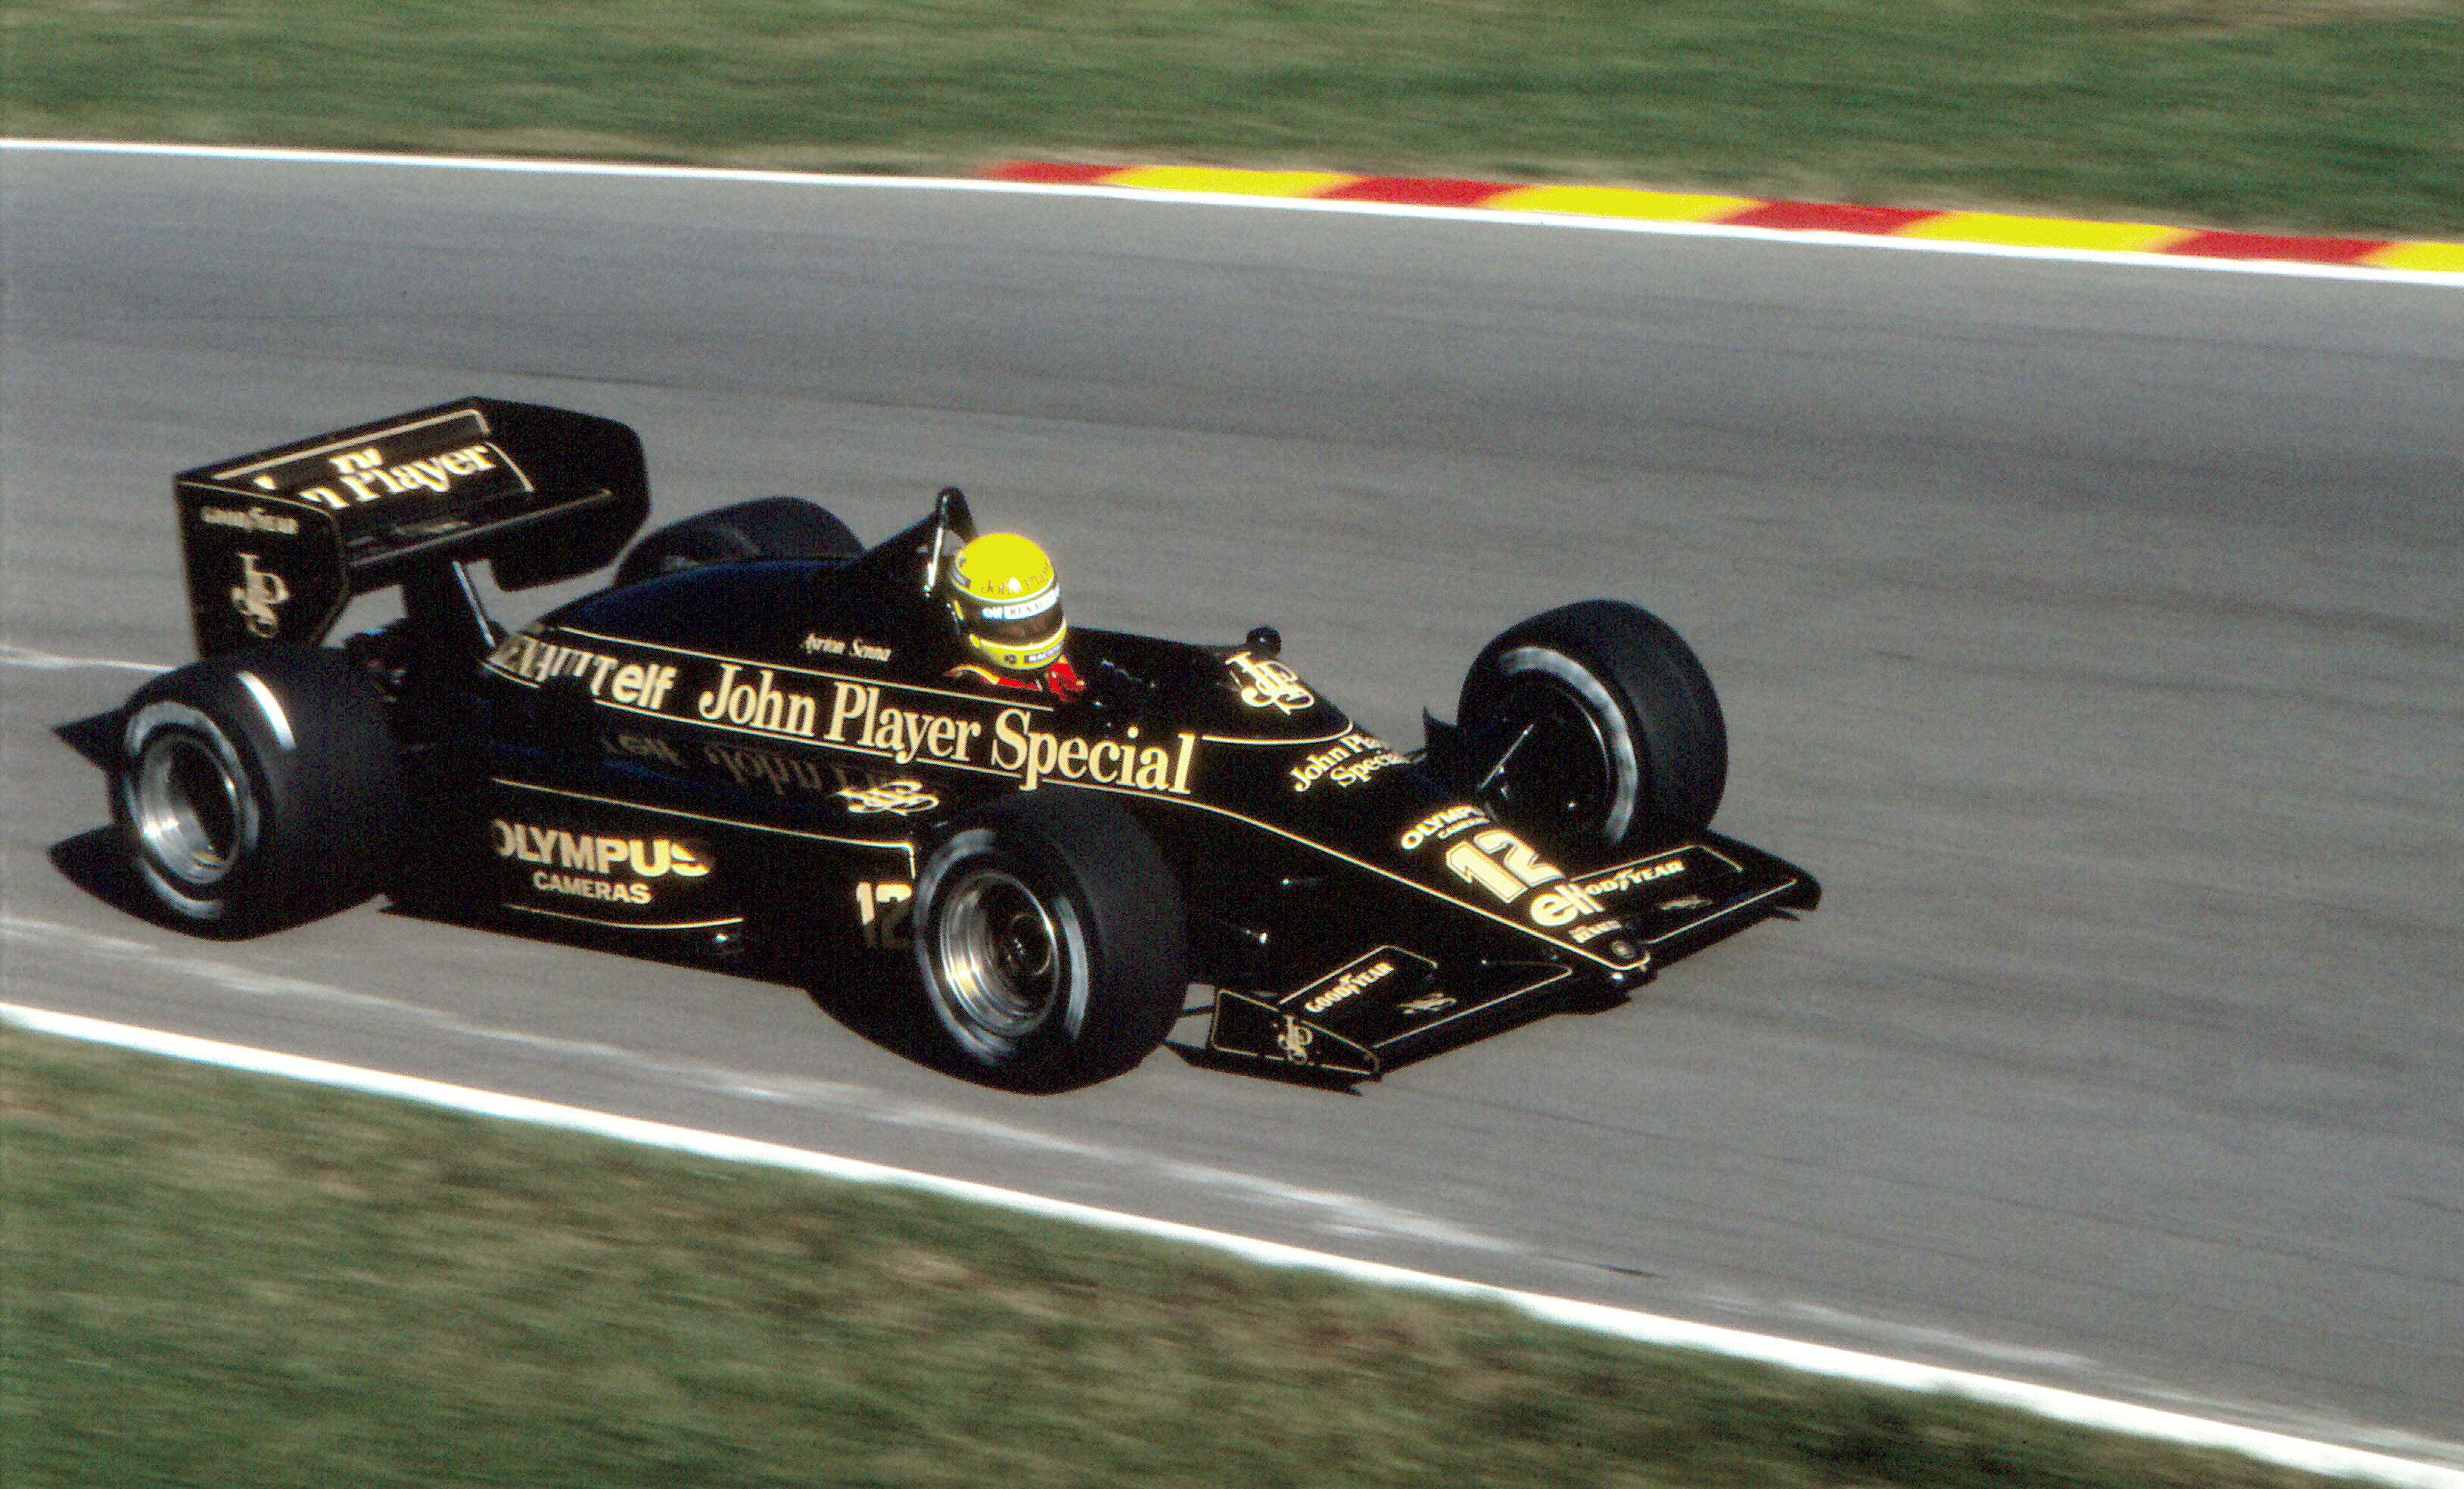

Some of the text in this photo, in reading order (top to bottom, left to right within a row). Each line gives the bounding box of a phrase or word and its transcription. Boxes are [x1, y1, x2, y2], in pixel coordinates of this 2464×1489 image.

[611, 664, 678, 710] elf
[698, 663, 815, 738] John
[824, 682, 981, 763] Player
[991, 708, 1195, 794] Special
[1290, 746, 1351, 792] John
[533, 870, 652, 904] CAMERAS
[1445, 828, 1565, 903] 12
[1585, 860, 1686, 895] ODYEAR
[1530, 882, 1605, 927] elf
